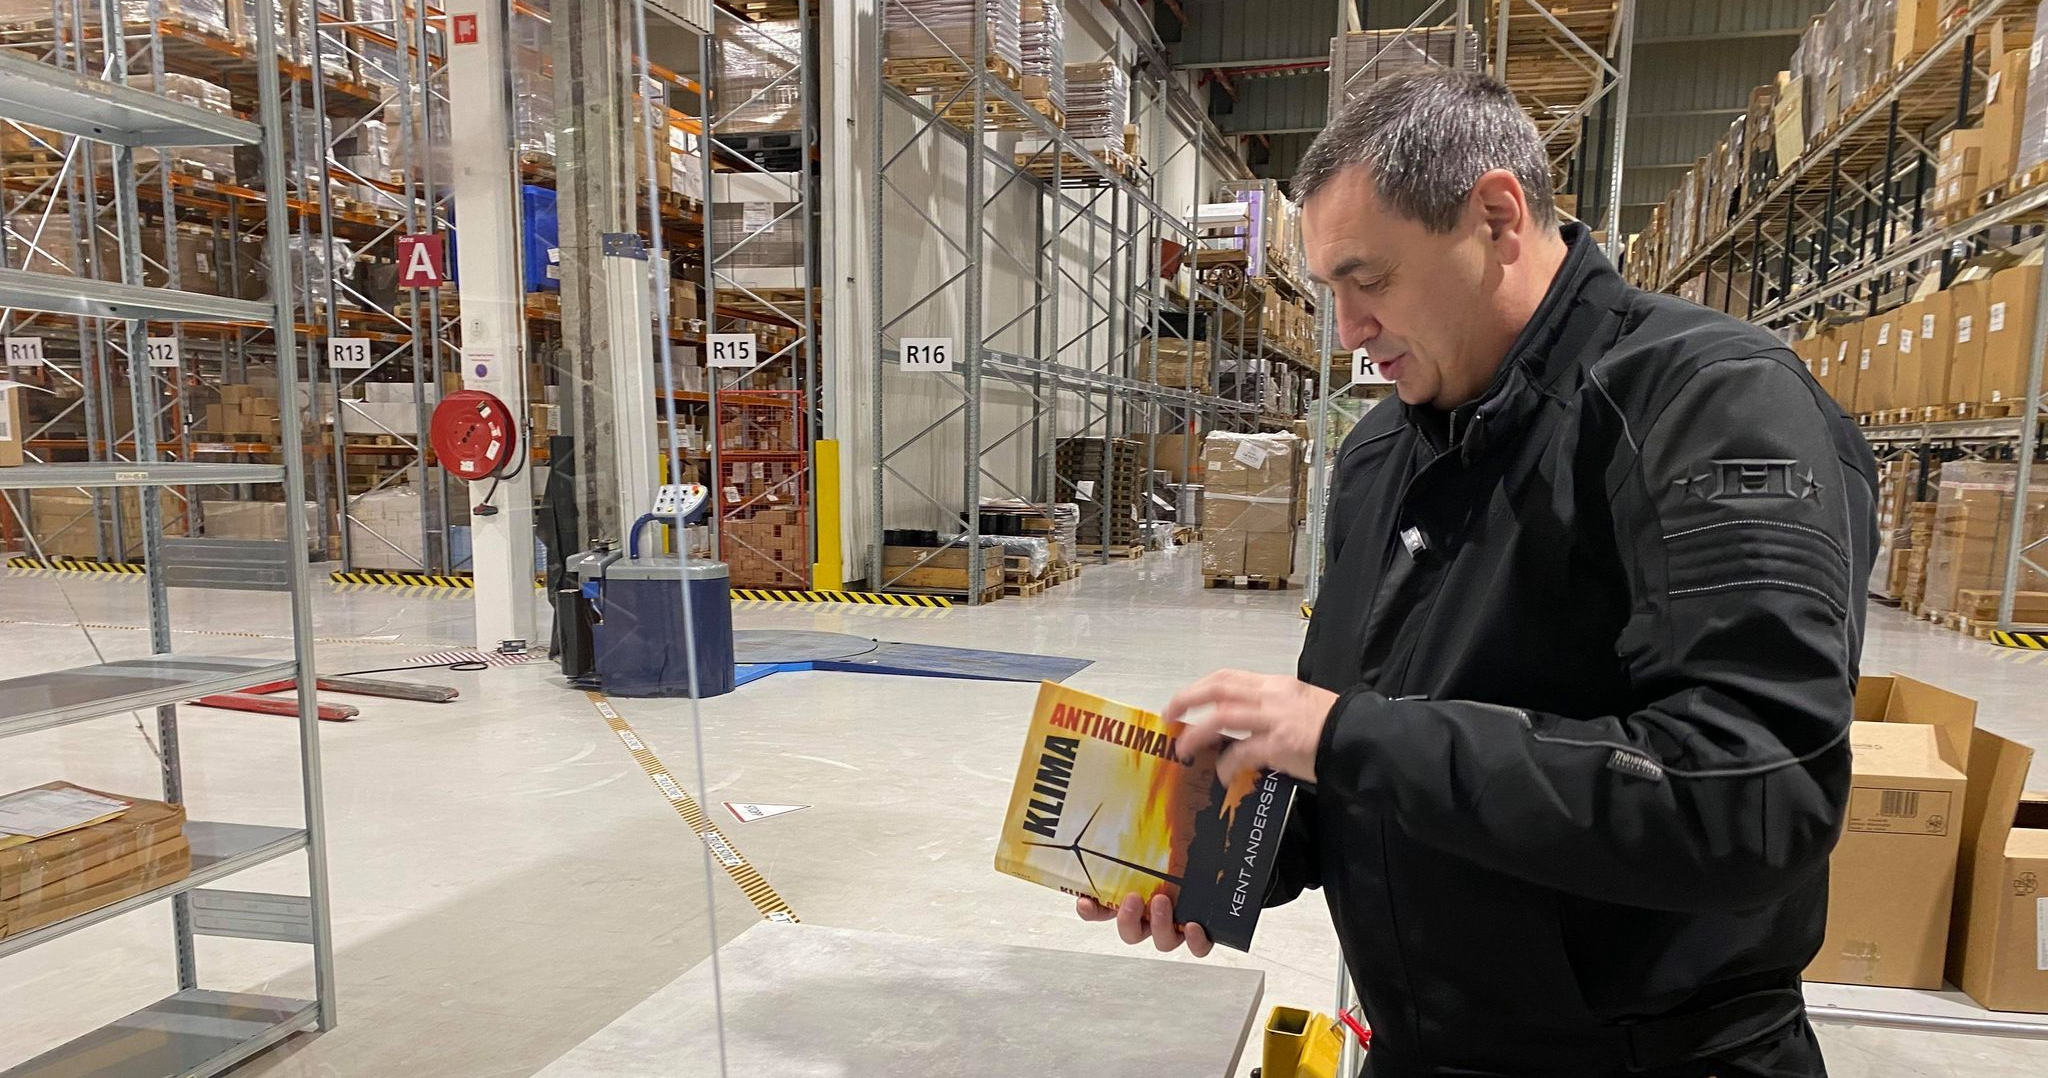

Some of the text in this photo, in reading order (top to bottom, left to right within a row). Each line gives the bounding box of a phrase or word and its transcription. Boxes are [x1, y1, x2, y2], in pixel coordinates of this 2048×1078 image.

[405, 242, 438, 280] A
[11, 343, 38, 360] R11
[334, 345, 364, 361] R13
[713, 341, 749, 360] R15
[906, 345, 945, 364] R16
[1022, 735, 1081, 838] KLIMA
[1229, 767, 1281, 917] KENT ANDERSEN
